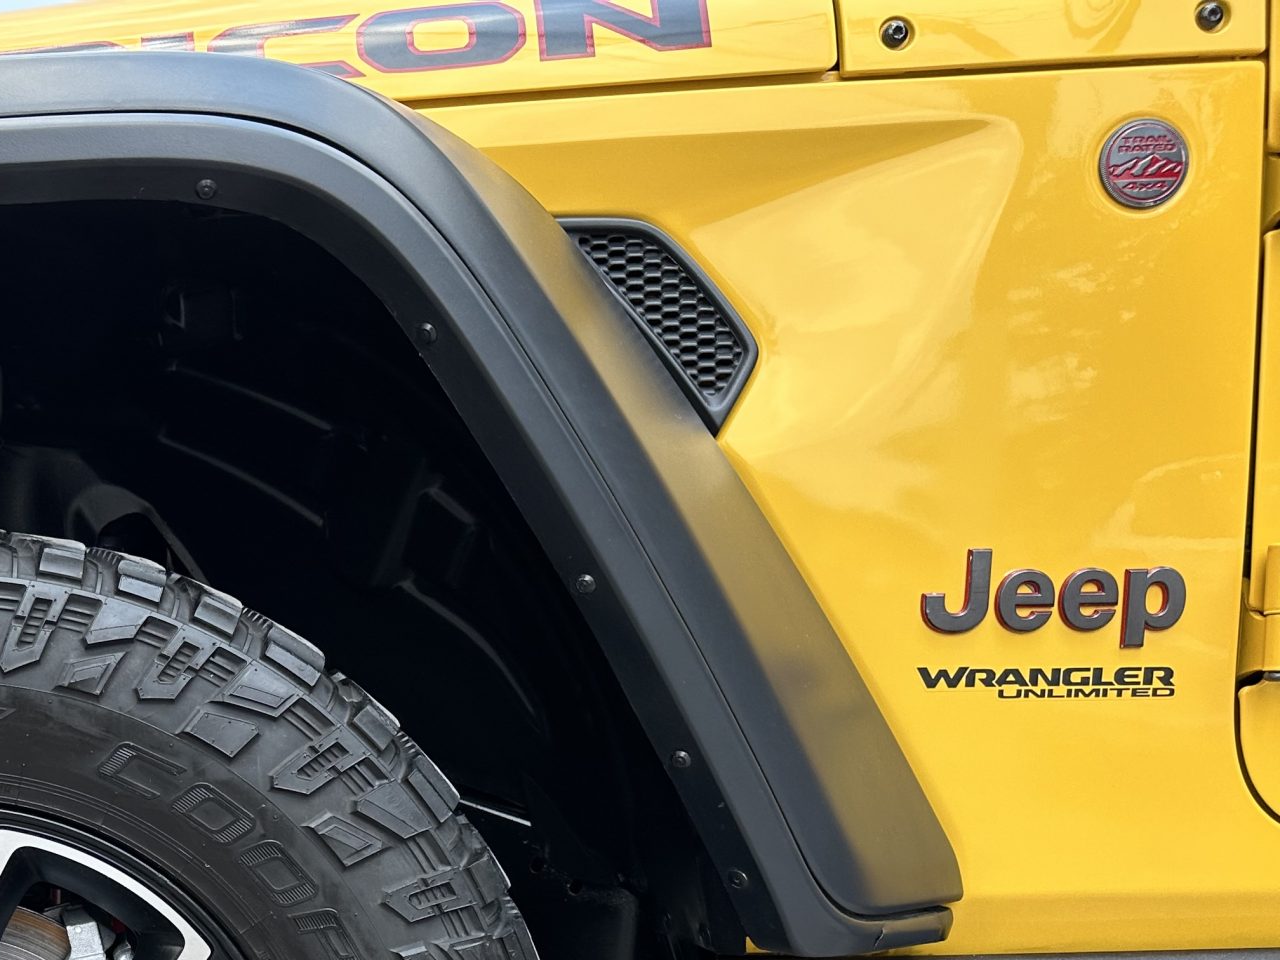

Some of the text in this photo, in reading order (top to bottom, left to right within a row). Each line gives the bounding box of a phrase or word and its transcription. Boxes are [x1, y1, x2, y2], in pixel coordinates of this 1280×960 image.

[1122, 134, 1173, 145] TRAIL
[1118, 143, 1177, 154] RATED
[920, 548, 1187, 650] Jeep
[917, 666, 1176, 689] WRANGLER
[997, 687, 1176, 699] UNLIMITED
